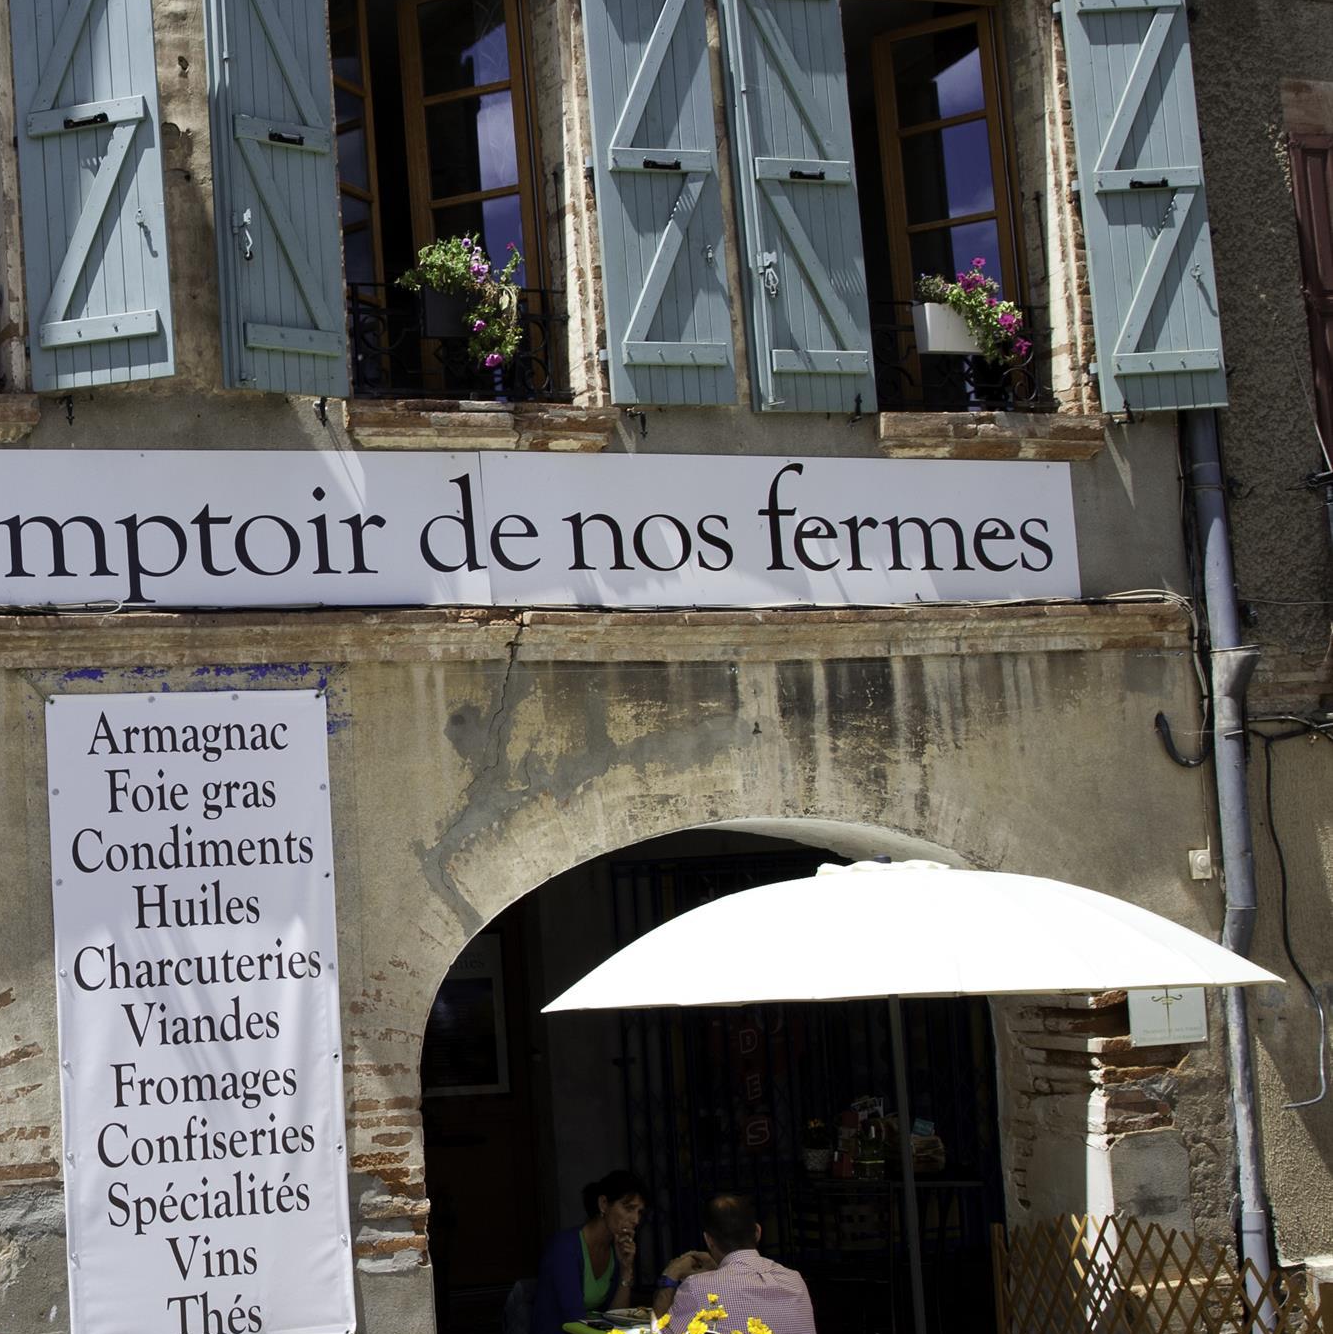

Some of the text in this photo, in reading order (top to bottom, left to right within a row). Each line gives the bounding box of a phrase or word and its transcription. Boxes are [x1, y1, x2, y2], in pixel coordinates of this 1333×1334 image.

[419, 473, 541, 572] de
[562, 511, 734, 572] nos
[757, 463, 1054, 572] fermes
[87, 711, 289, 762] Armagnac
[104, 768, 276, 820] Foie gras
[72, 824, 314, 873] Condiments
[132, 879, 261, 929] Huiles
[74, 938, 322, 991] Charcuteries
[121, 996, 280, 1047] Viandes
[110, 1062, 297, 1109] Fromages
[97, 1113, 315, 1168] Confiseries
[108, 1170, 311, 1236] Spécialités
[166, 1235, 258, 1281] Vins
